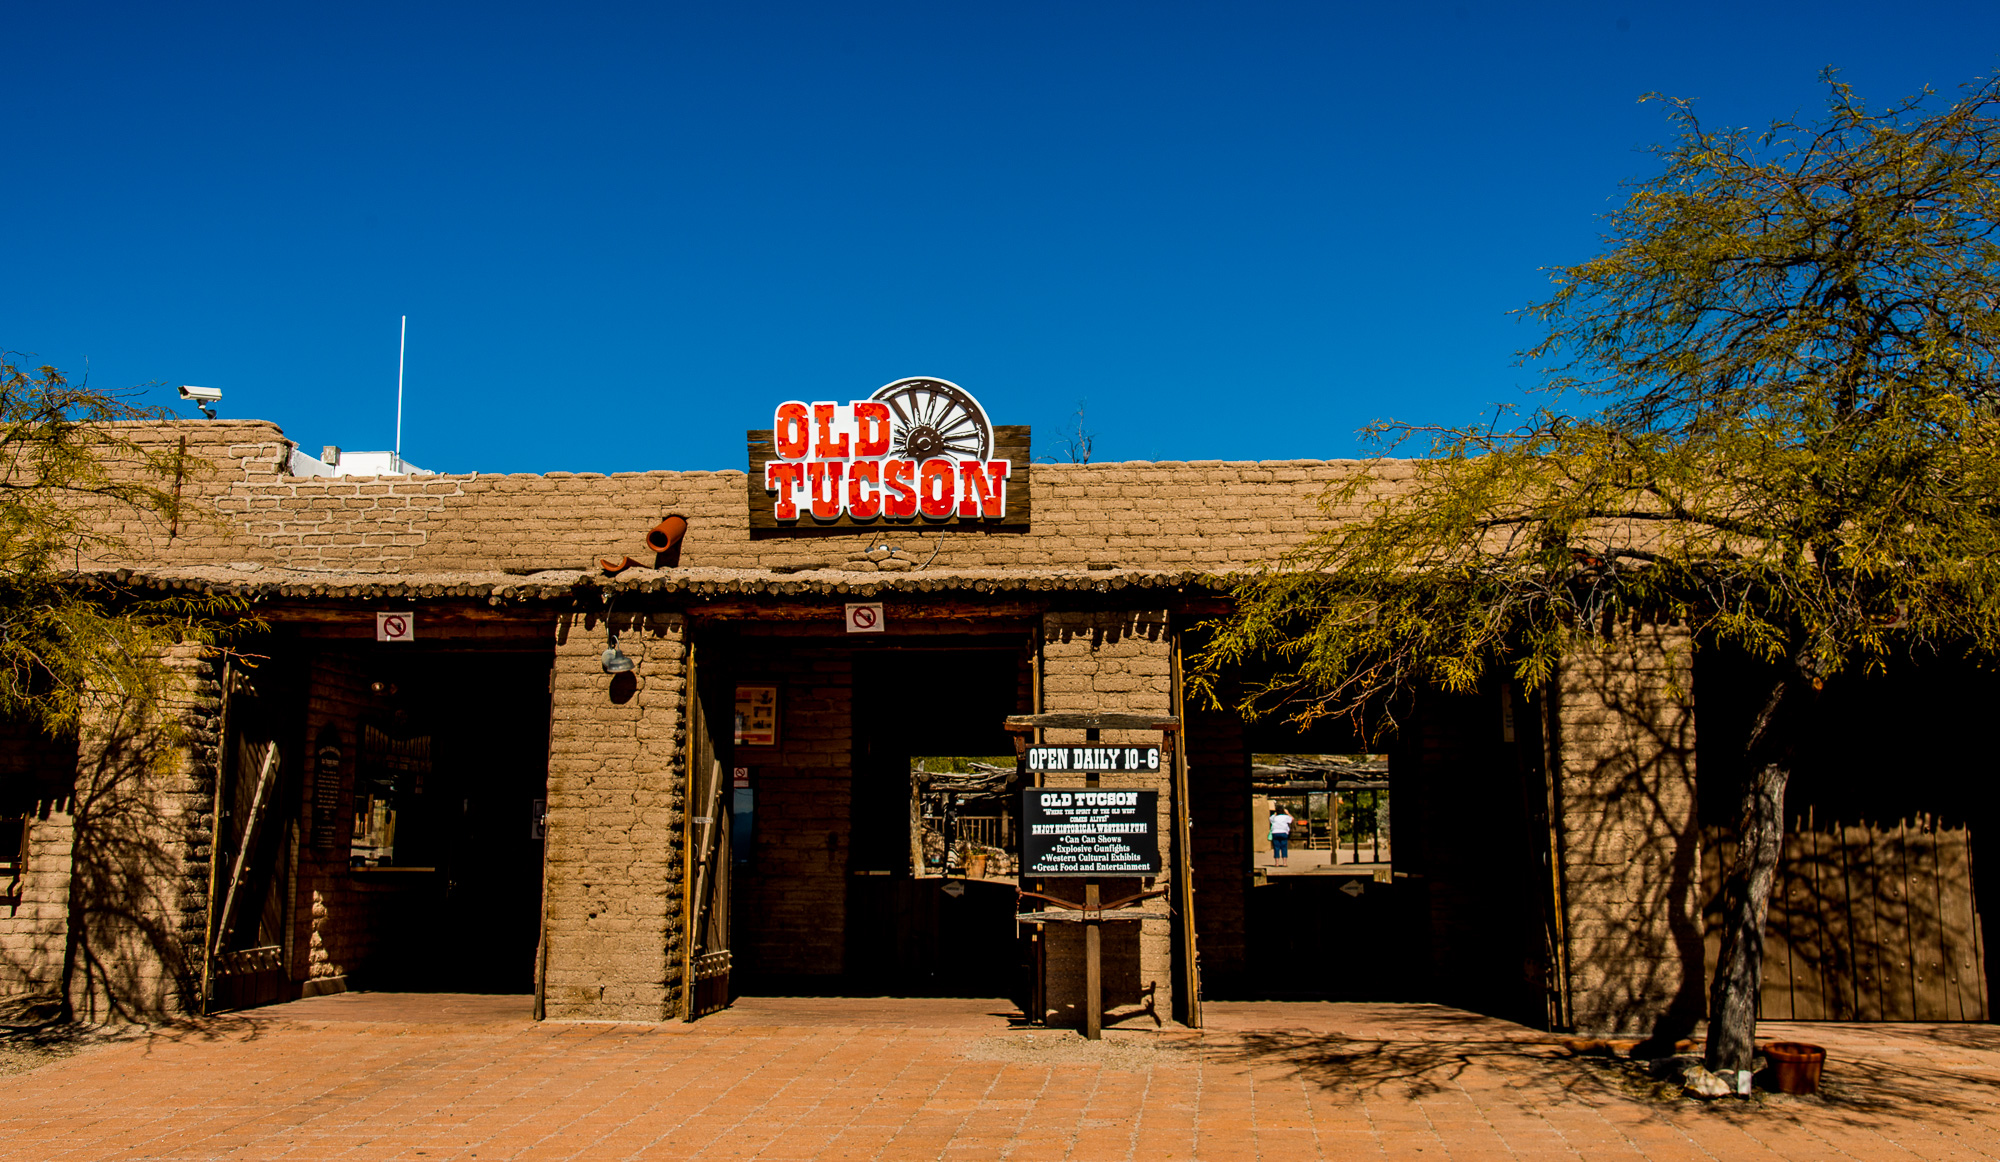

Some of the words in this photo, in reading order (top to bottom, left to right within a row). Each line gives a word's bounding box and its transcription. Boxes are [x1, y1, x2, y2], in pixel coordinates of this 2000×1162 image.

[776, 402, 891, 460] OLD
[767, 458, 1009, 519] TUCSON
[1029, 748, 1069, 770] OPEN
[1073, 748, 1121, 770] DAILY
[1124, 748, 1159, 770] 10-6
[1040, 794, 1072, 807] OLD
[1075, 793, 1138, 806] TUCSON
[1032, 824, 1055, 834] ENJOY
[1055, 824, 1096, 834] HISTORICAL
[1096, 823, 1130, 833] WESTERN
[1130, 823, 1148, 833] FUN!
[1065, 835, 1080, 843] Can
[1081, 835, 1096, 843] Can
[1098, 835, 1122, 843] Shows
[1056, 844, 1092, 854] Explosive
[1094, 844, 1131, 854] Gunfights
[1045, 853, 1077, 862] Western
[1078, 853, 1109, 862] Cultural
[1111, 853, 1141, 861] Exhibits
[1037, 863, 1059, 871] Great
[1060, 863, 1079, 871] Food
[1080, 862, 1095, 871] and
[1096, 862, 1151, 871] Entertainment
